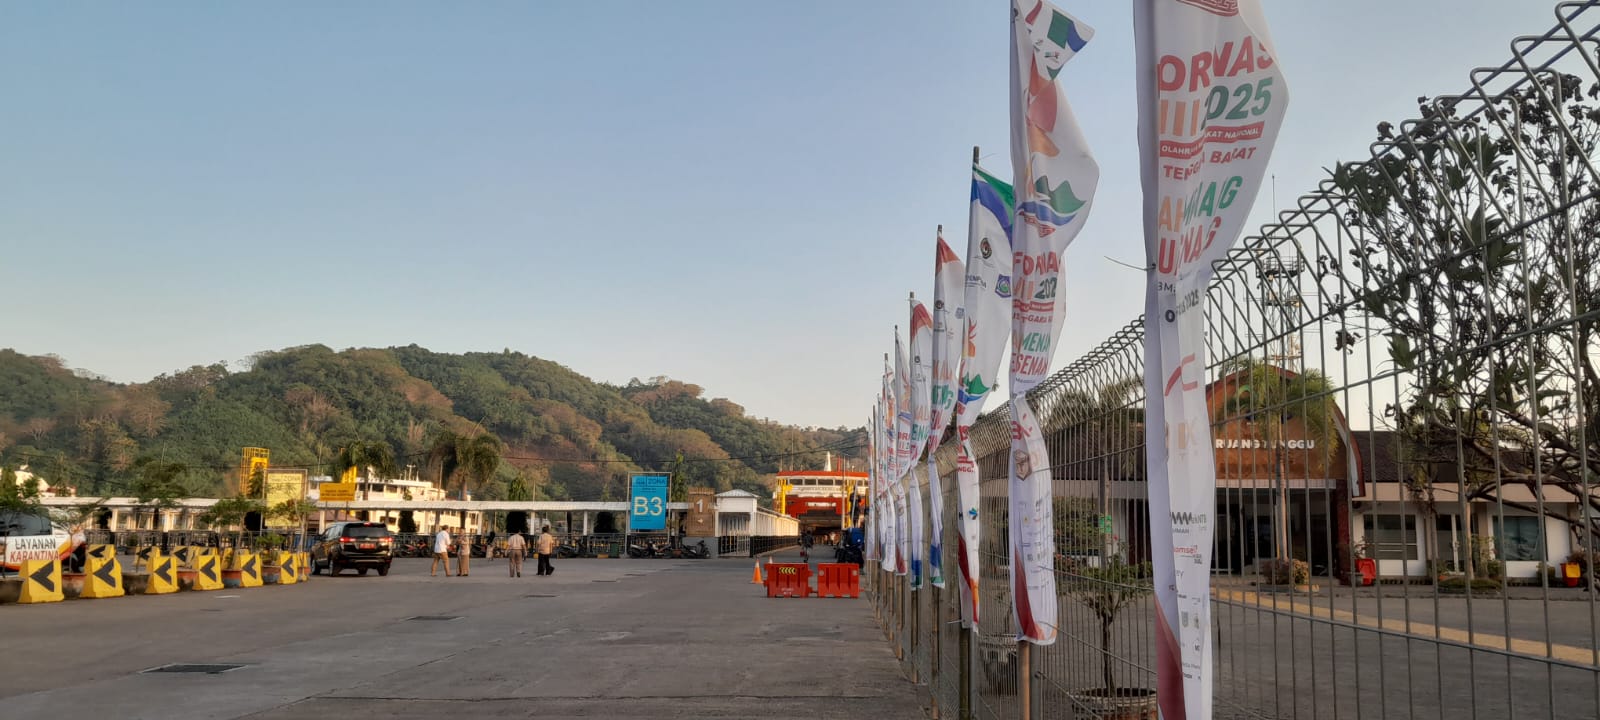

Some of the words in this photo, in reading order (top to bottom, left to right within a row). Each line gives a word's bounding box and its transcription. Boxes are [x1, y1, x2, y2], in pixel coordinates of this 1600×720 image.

[634, 496, 662, 516] B3
[15, 538, 56, 550] LAYANAN
[10, 550, 60, 562] KARANTINA
